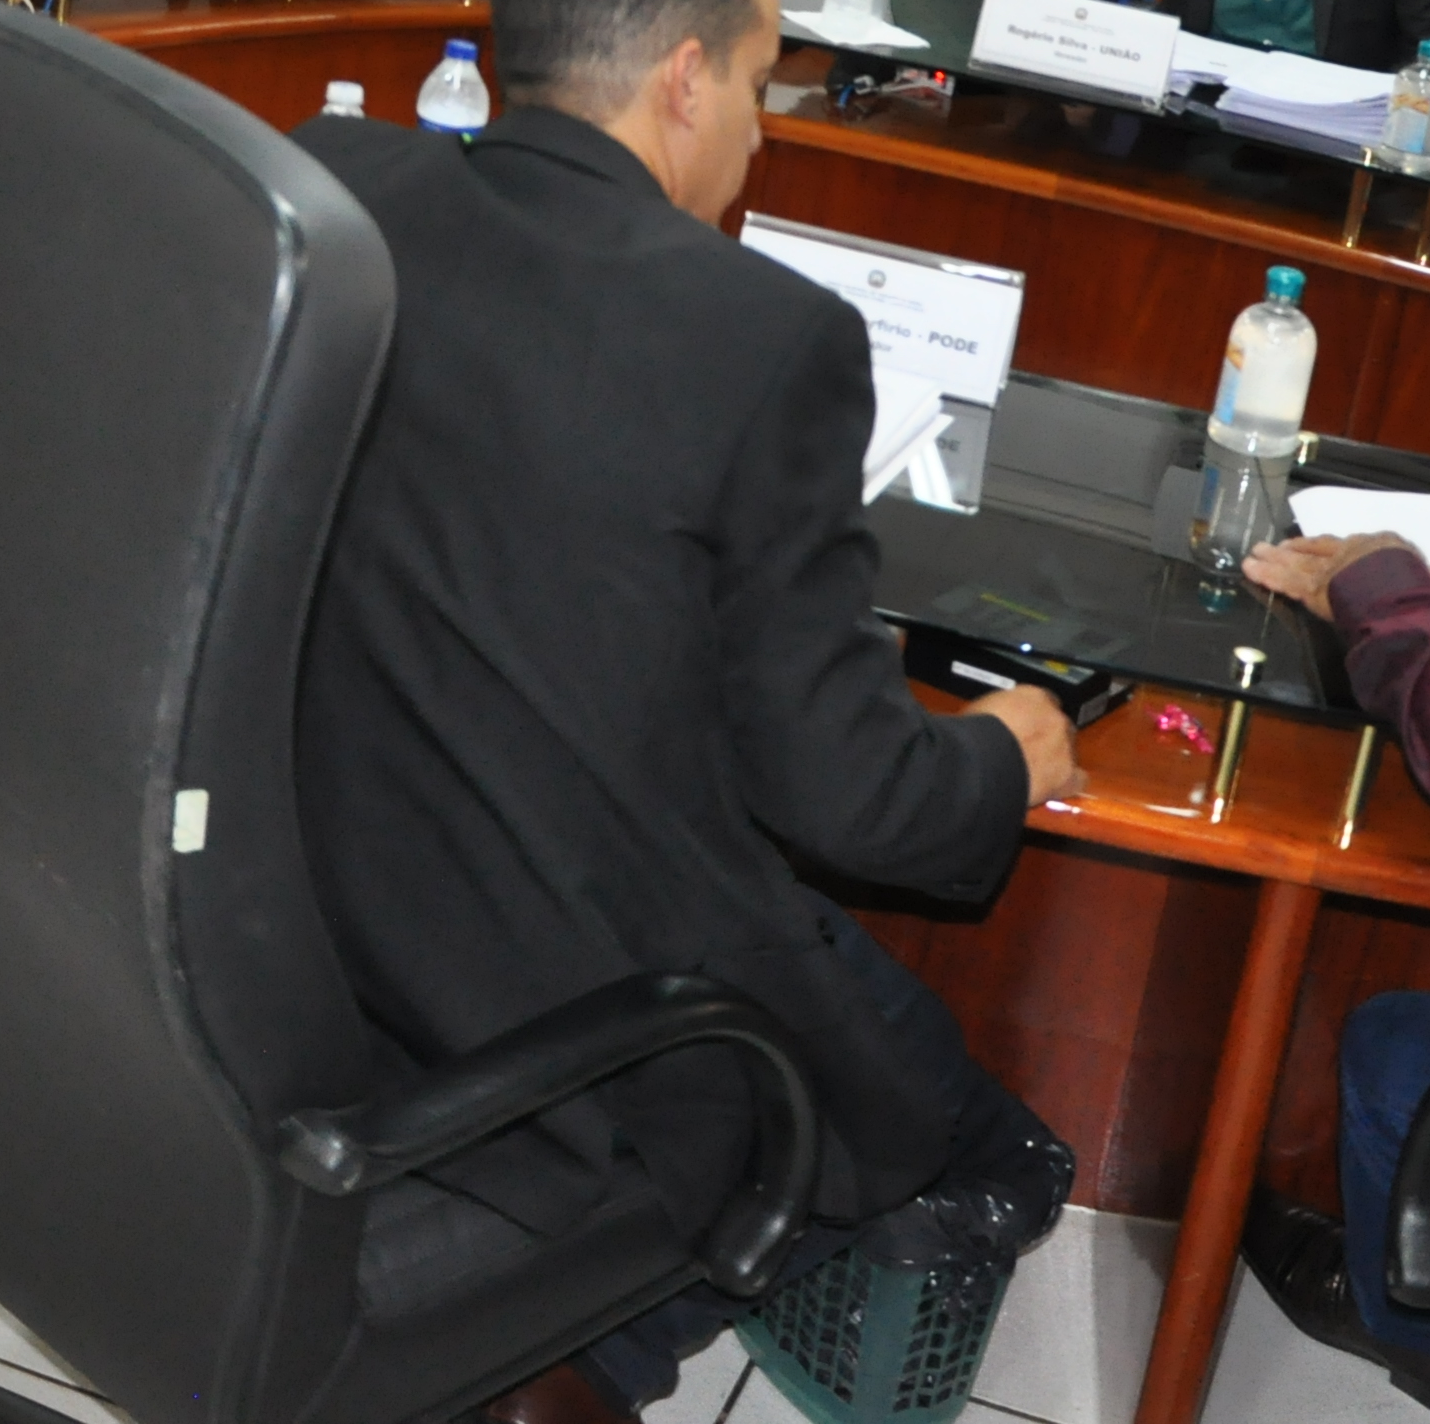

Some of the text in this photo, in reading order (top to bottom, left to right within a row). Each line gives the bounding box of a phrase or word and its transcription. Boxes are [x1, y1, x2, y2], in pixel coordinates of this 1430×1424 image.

[1007, 23, 1054, 43] Rogério
[1058, 35, 1088, 51] Silva
[1099, 45, 1141, 62] UNIÃO
[927, 331, 979, 355] PODE
